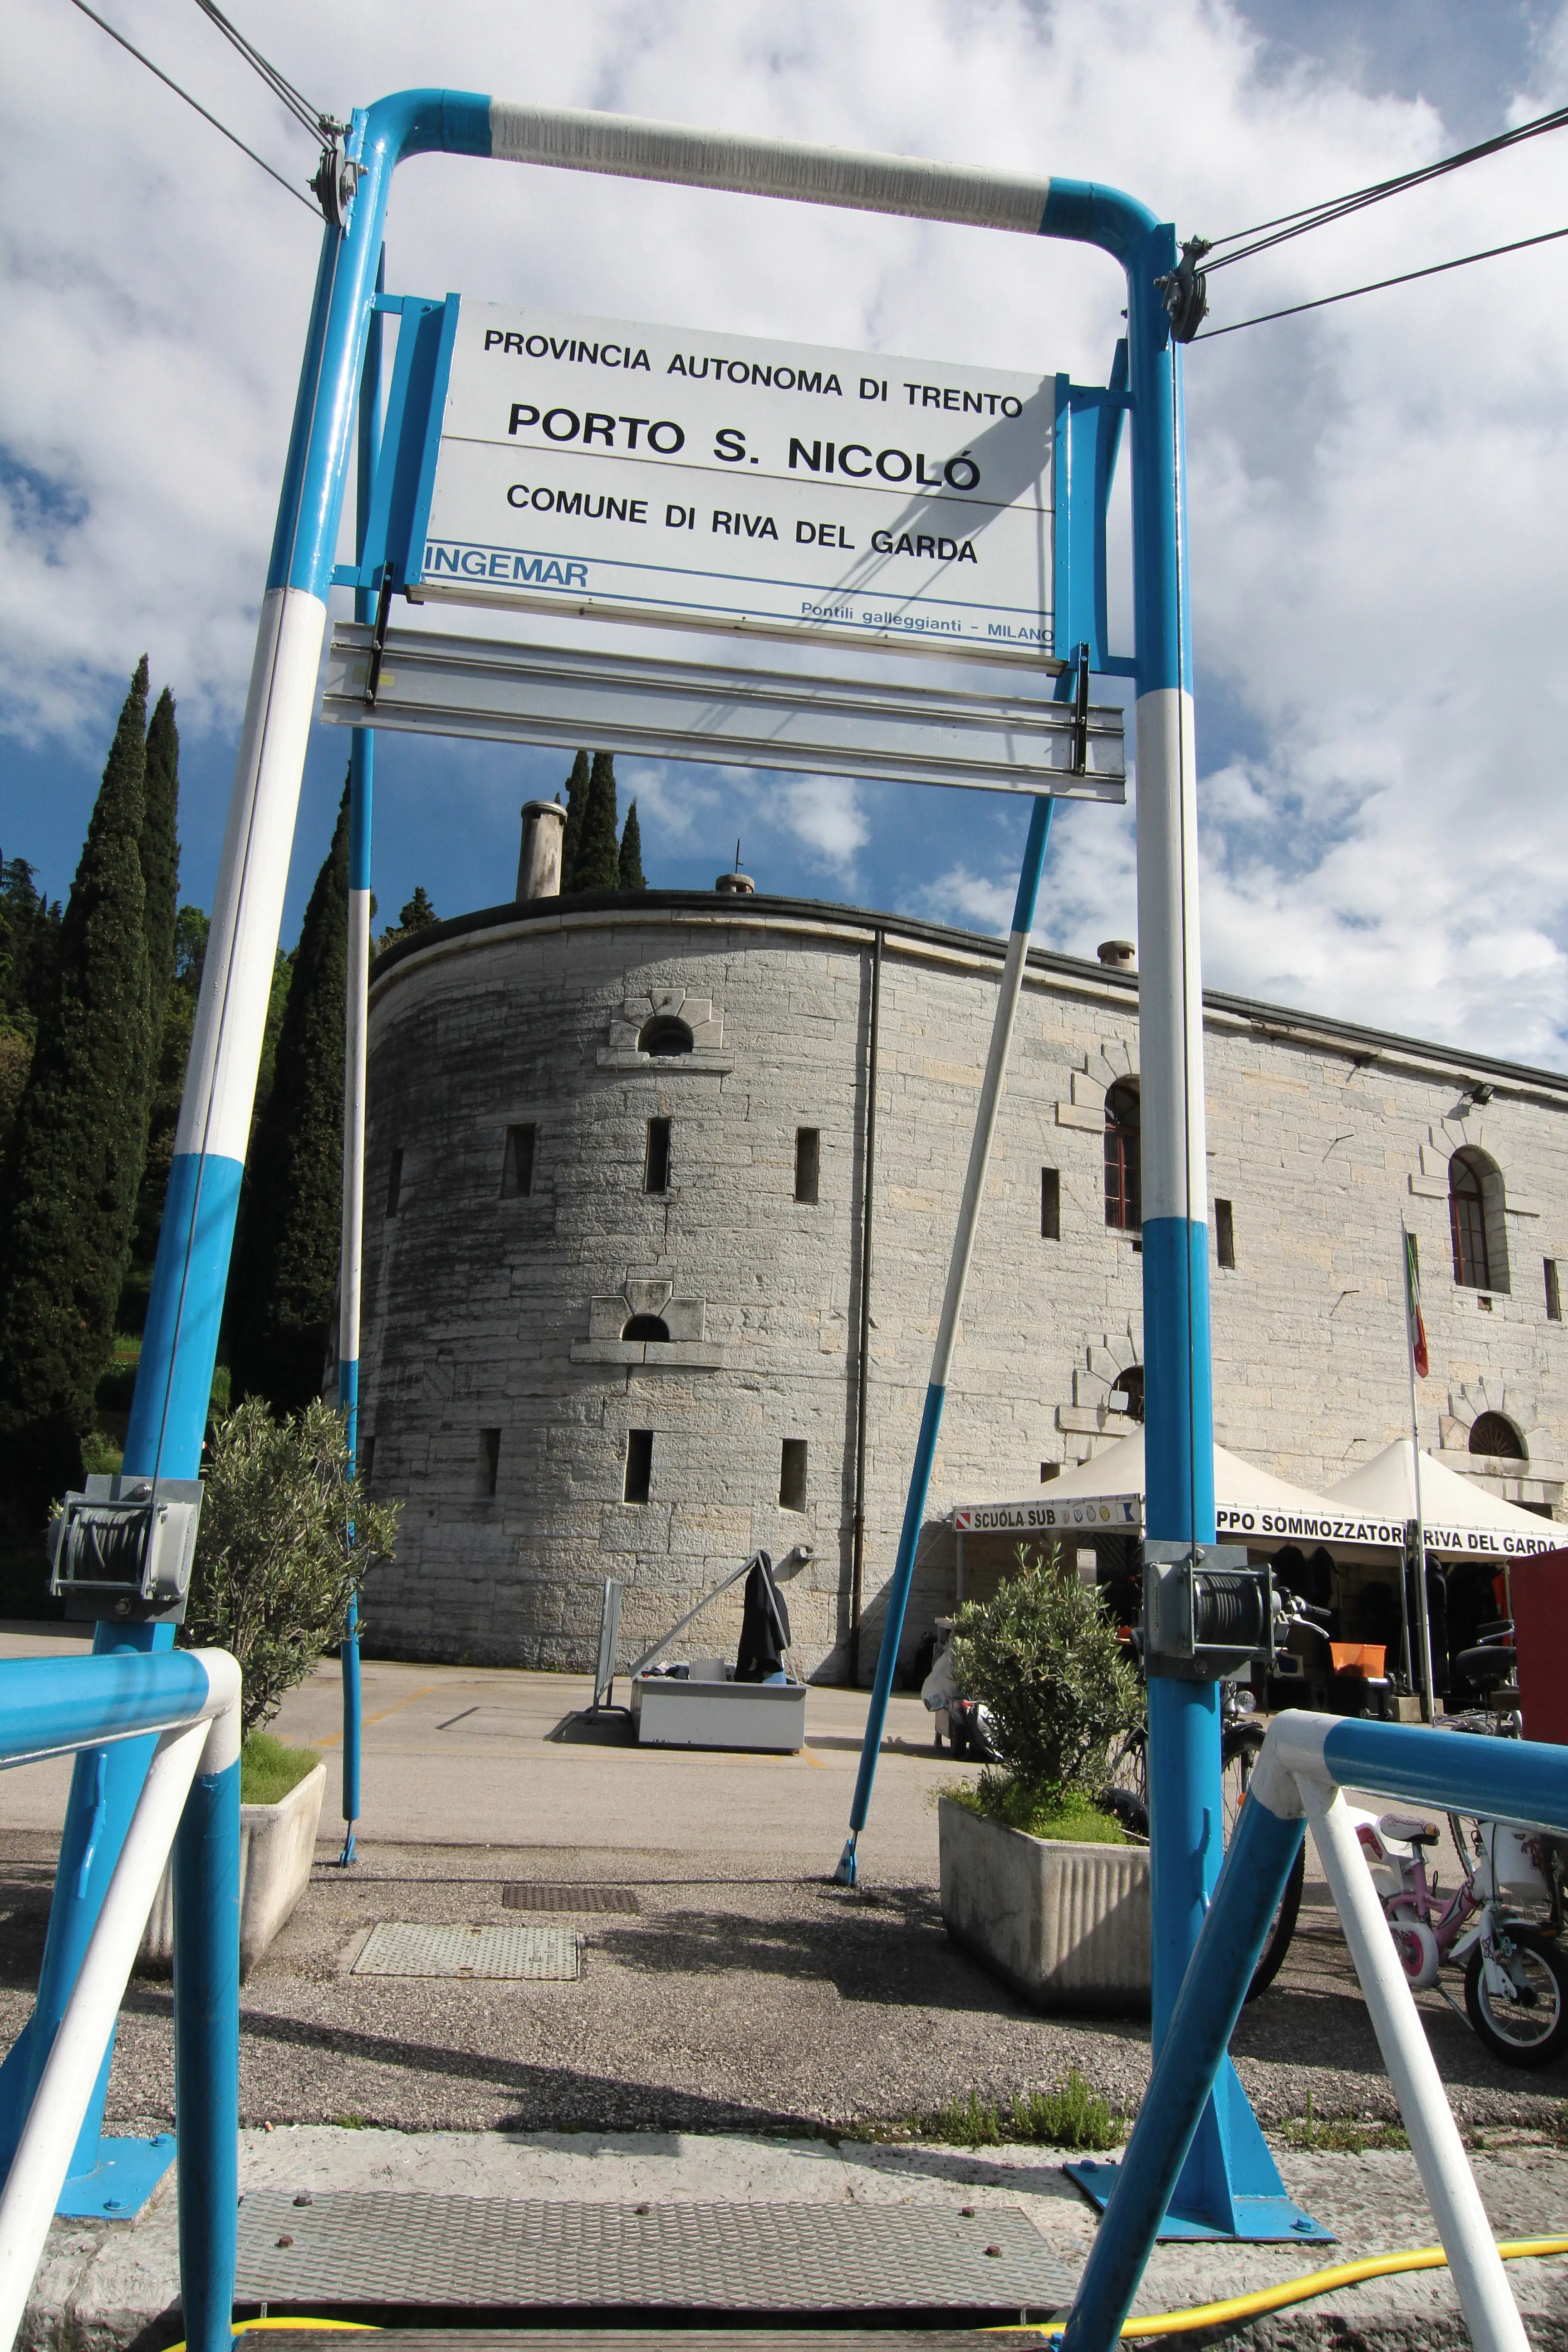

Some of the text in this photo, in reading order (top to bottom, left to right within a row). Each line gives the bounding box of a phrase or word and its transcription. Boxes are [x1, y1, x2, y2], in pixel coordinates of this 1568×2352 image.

[484, 329, 1024, 419] PROVINCIA AUTONOMA DI TRENTO
[508, 403, 685, 455] PORTO
[713, 428, 759, 464] S.
[506, 484, 978, 564] COMUNE DI RIVA DEL GARDA
[424, 546, 588, 588] INGEMAR
[801, 602, 853, 620] Pontili
[862, 610, 962, 632] galleggianti
[987, 623, 1055, 642] MILANO
[975, 1509, 1056, 1528] SCUOLA SUB
[1261, 1514, 1406, 1544] SOMMOZZATORI
[1423, 1529, 1556, 1555] RIVA DEL GARDA
